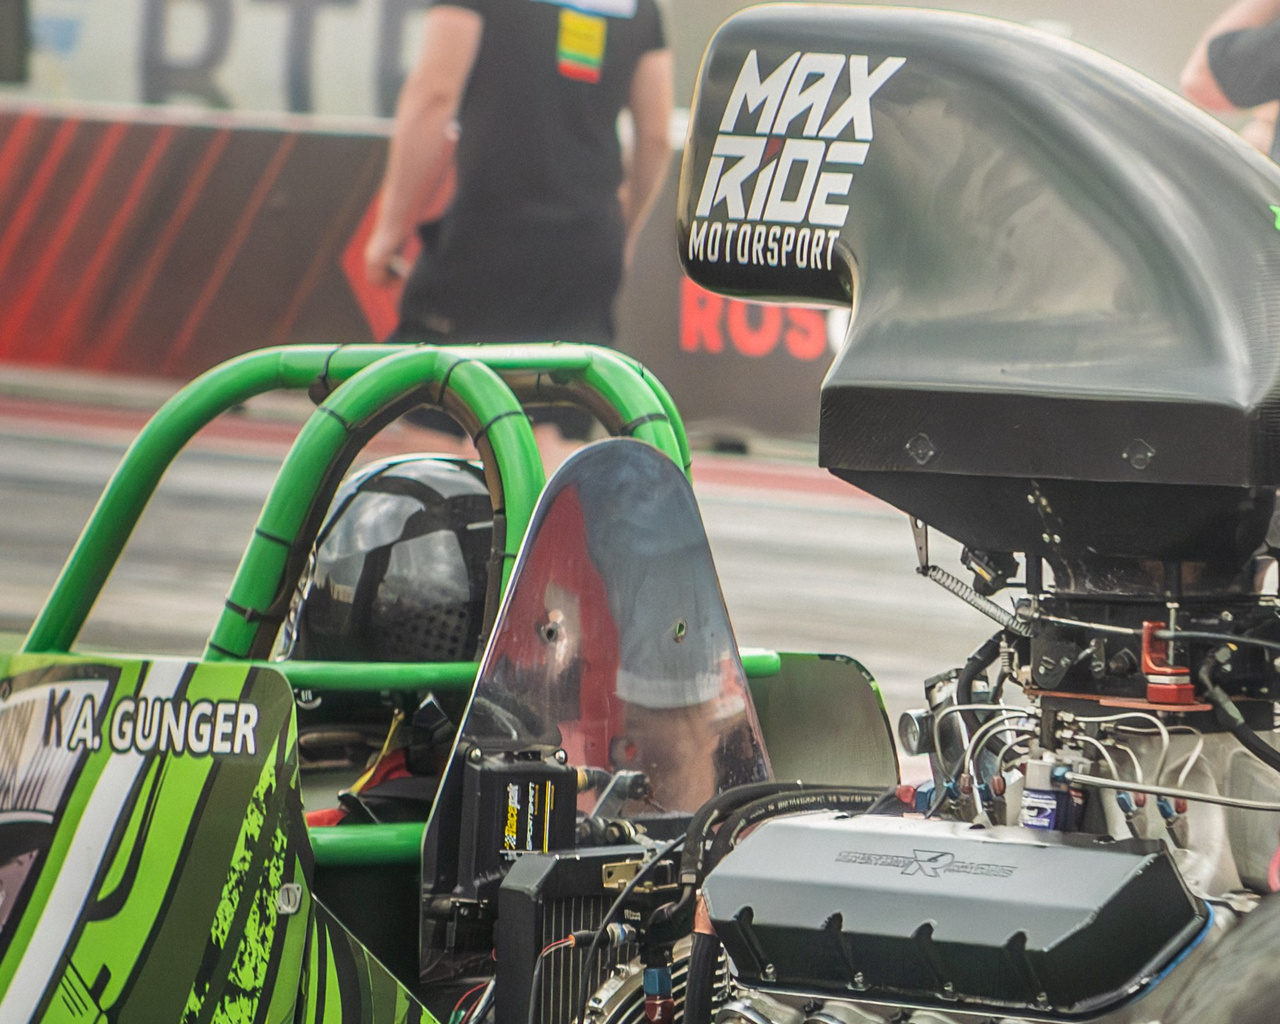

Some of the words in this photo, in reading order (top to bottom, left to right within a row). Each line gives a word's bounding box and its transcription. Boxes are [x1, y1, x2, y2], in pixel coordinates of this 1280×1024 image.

[718, 49, 907, 141] MAX
[695, 134, 871, 227] RIDE
[688, 219, 841, 271] MOTORSPORT
[110, 698, 260, 756] GUNGER
